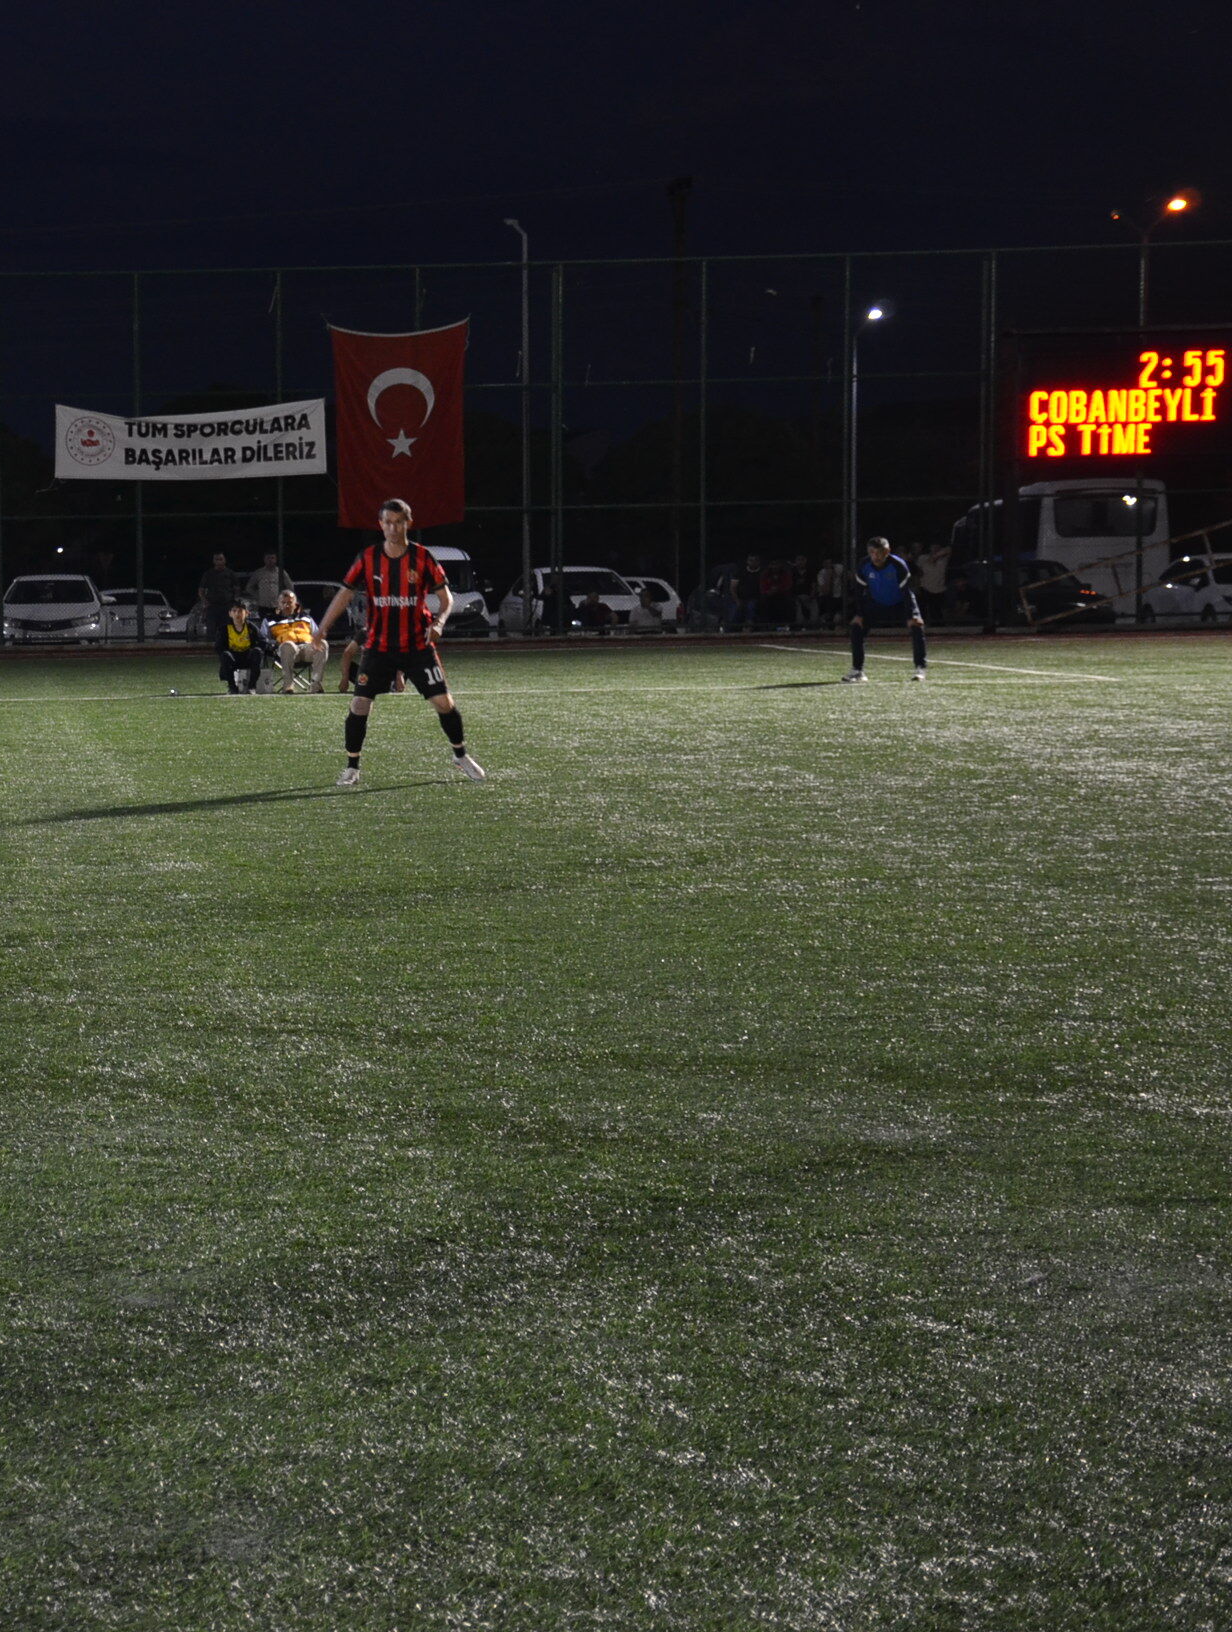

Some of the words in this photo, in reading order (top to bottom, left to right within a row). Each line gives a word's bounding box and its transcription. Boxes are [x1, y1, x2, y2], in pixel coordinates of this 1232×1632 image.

[173, 413, 311, 439] SPORCULARA
[1028, 424, 1066, 457] PS
[124, 445, 236, 471] BAŞARILAR
[241, 436, 317, 464] DİLERİZ
[424, 666, 444, 685] 10
